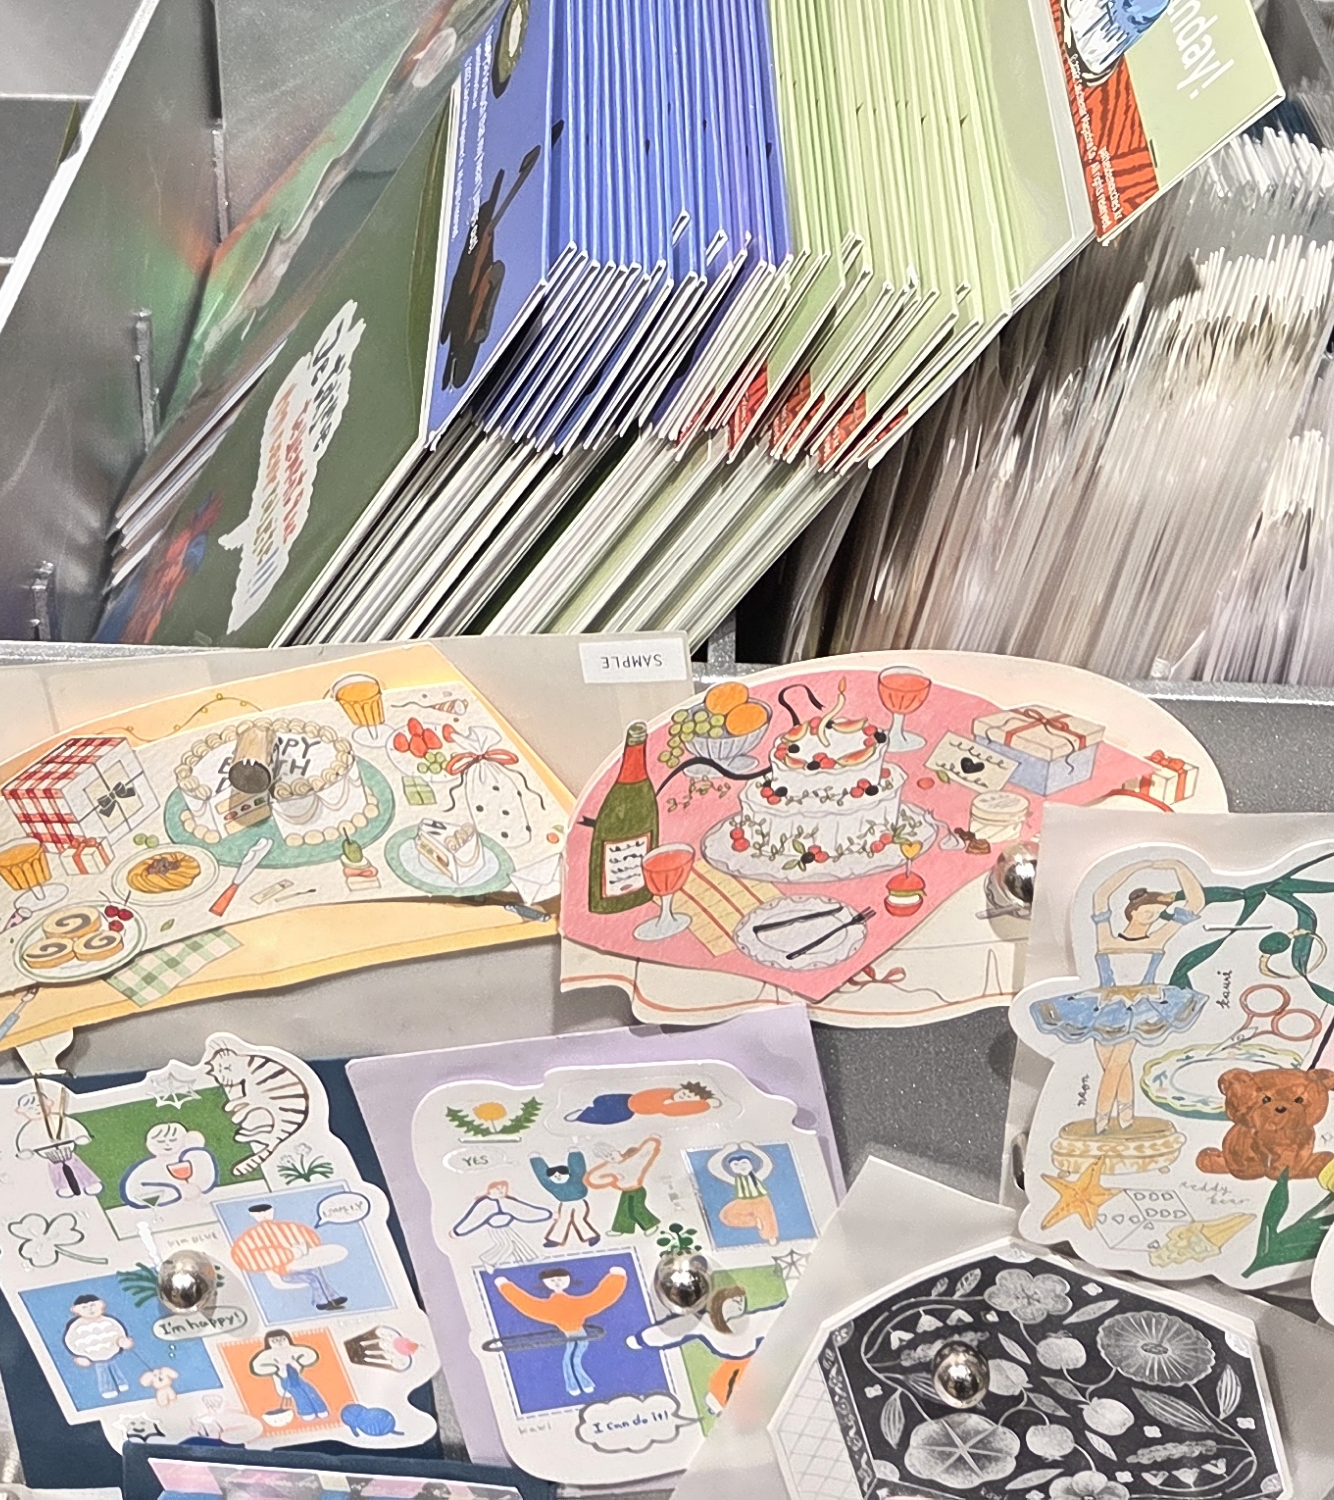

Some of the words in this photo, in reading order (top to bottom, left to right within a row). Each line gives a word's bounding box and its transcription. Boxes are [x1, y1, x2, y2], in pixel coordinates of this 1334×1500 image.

[600, 653, 663, 669] SAMPLE
[462, 1155, 490, 1167] YES
[158, 1320, 185, 1336] I'm
[186, 1311, 241, 1336] happy!
[633, 1416, 649, 1427] do
